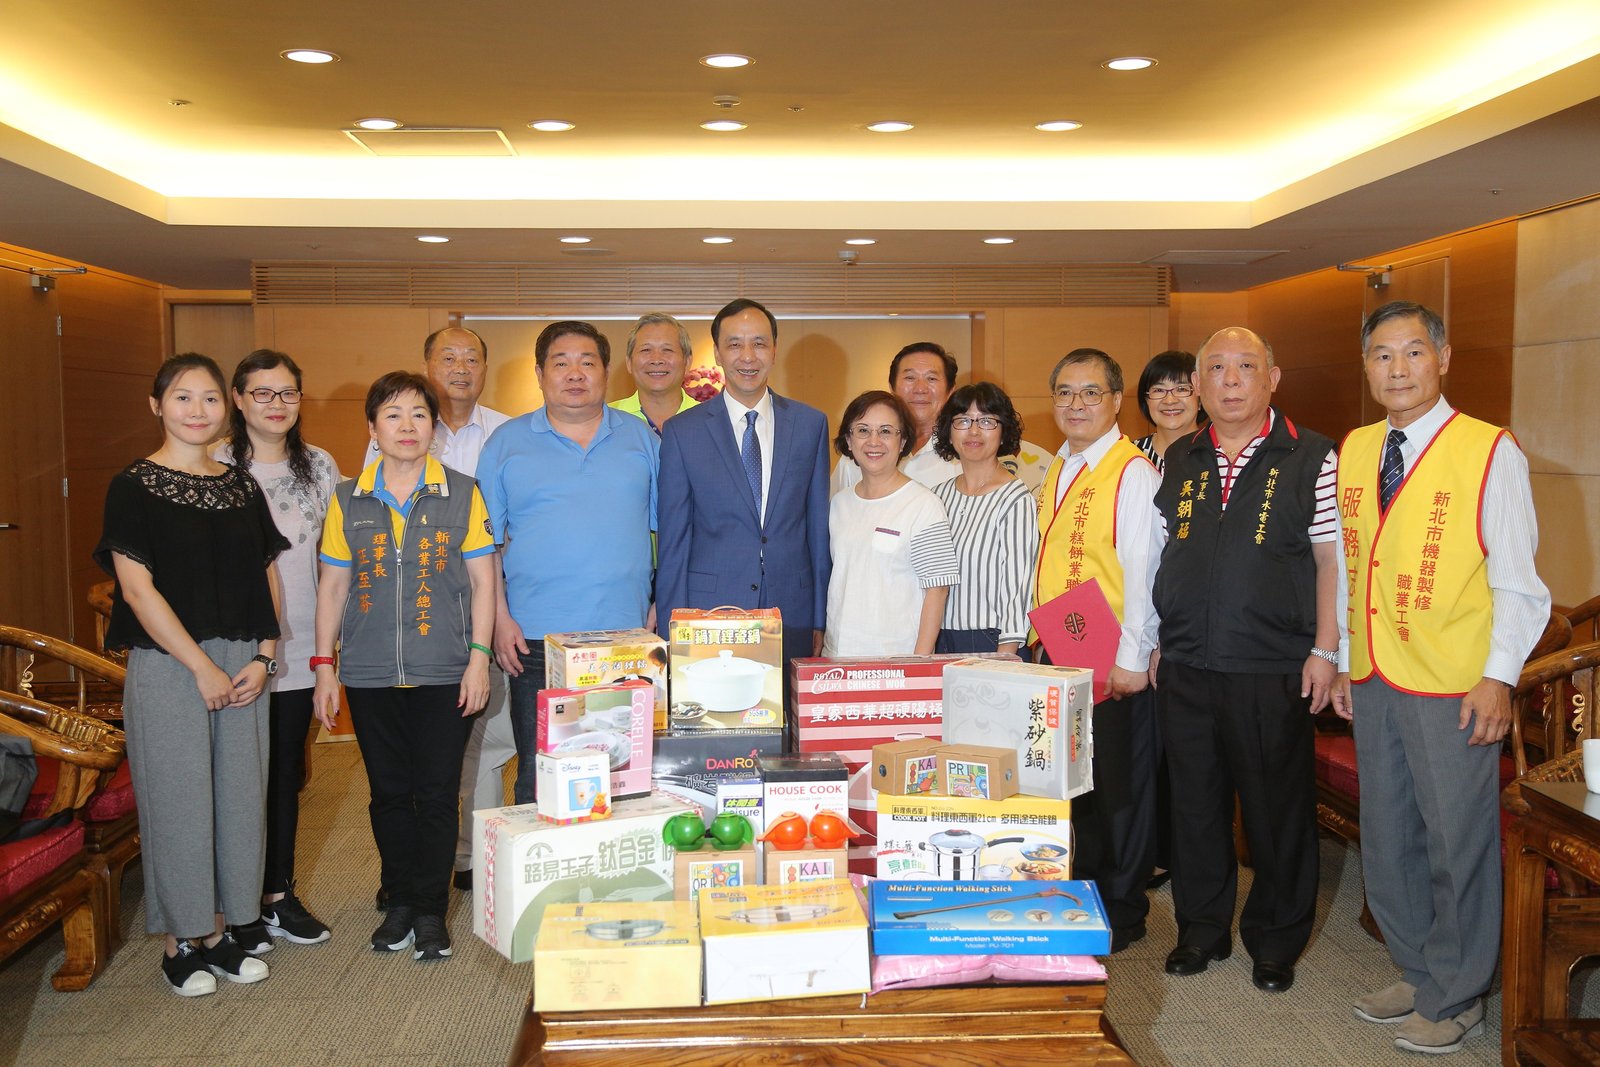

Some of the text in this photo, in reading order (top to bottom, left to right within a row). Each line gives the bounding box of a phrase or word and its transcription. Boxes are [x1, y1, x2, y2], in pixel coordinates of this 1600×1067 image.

[1196, 470, 1210, 501] 理事長
[1176, 479, 1194, 540] 吳朝福
[1254, 467, 1280, 545] 新北市水電工會
[372, 533, 388, 577] 理事長
[435, 531, 451, 573] 新北市
[1413, 490, 1451, 611] 新北市機器製修
[416, 537, 433, 636] 各業工人總工會
[1395, 574, 1413, 643] 職業工會
[813, 671, 841, 681] ROYAL
[846, 669, 906, 680] PROFESSIONAL
[846, 679, 906, 690] CHINESE WOK
[631, 689, 647, 758] CORELLE
[1024, 698, 1046, 771] 紫砂鍋
[705, 757, 754, 770] DANRO
[769, 785, 842, 795] HOUSE COOK
[1000, 813, 1057, 825] 多用途全能鍋
[524, 854, 596, 884] 路易王子
[598, 834, 656, 873] 鈦合金
[888, 884, 1012, 894] Multi-Function Walking Stick
[929, 935, 1049, 943] Multi-Function Walking Stick
